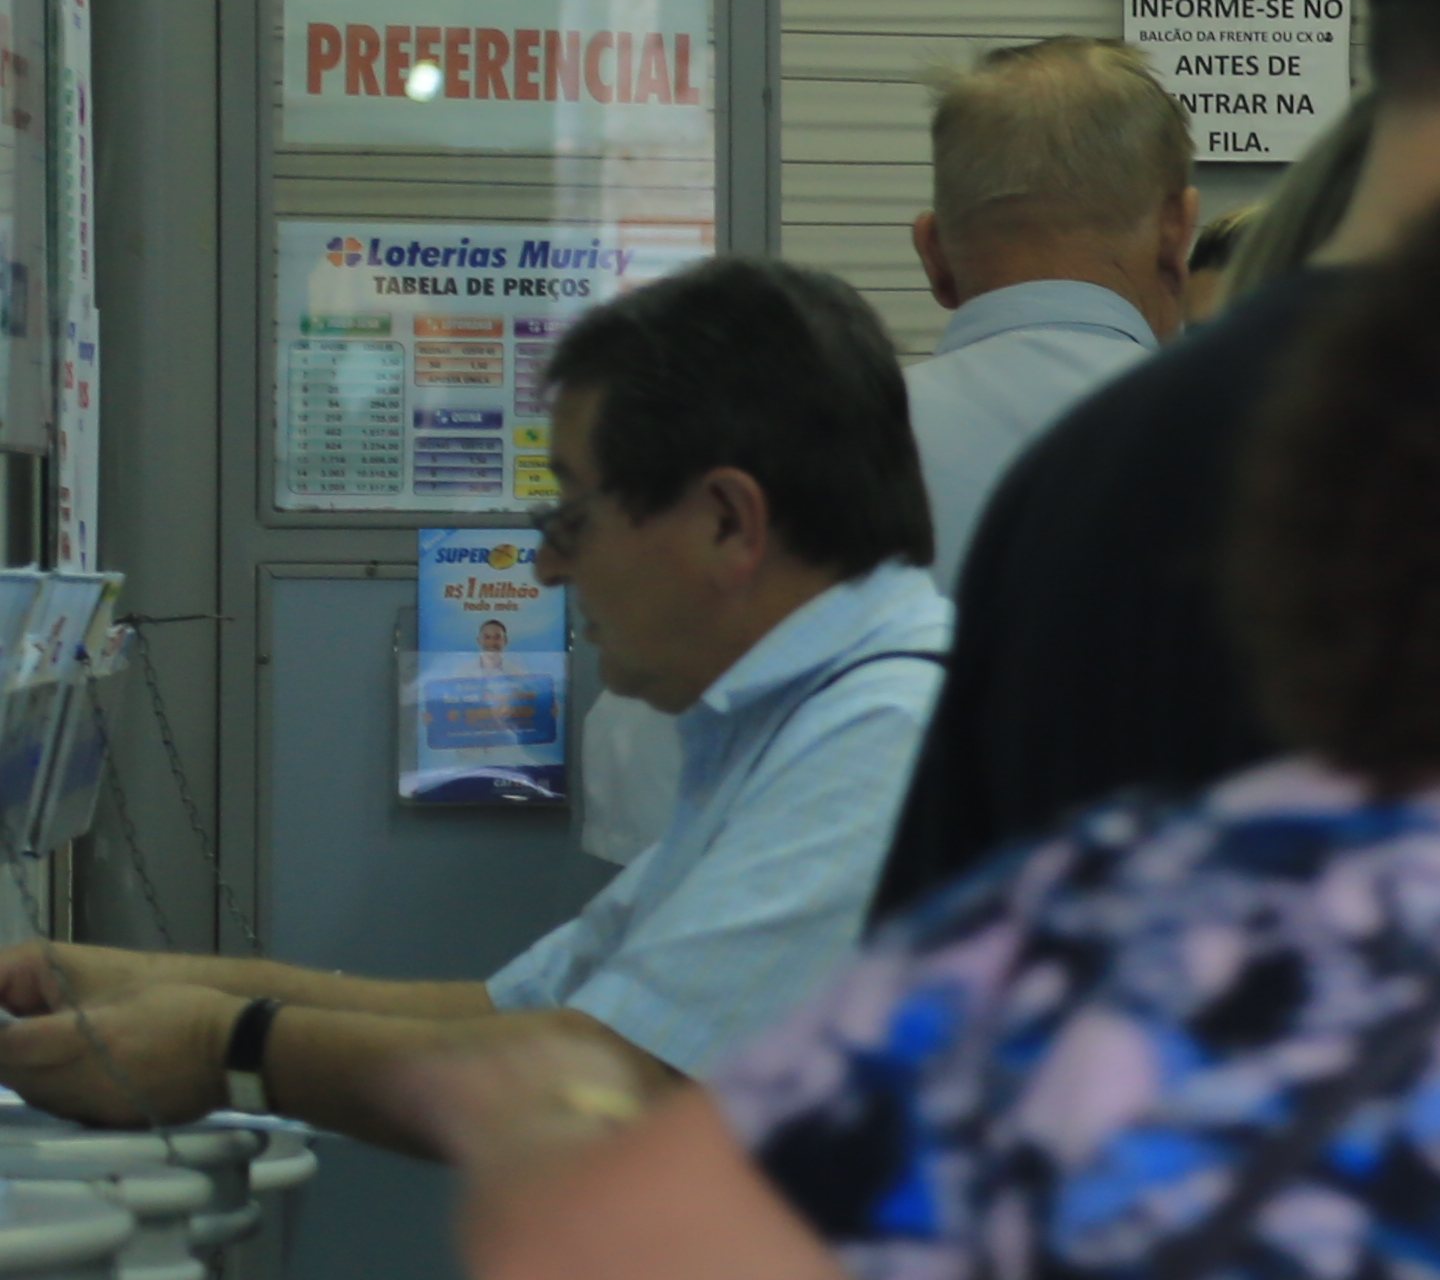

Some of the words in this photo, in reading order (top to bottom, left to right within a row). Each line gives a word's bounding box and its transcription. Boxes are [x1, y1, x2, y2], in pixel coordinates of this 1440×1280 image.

[1139, 28, 1193, 42] BALCÃO
[1197, 30, 1216, 42] DA
[1220, 30, 1268, 42] FRENTE
[1272, 31, 1292, 42] OU
[1296, 31, 1313, 42] CX
[306, 22, 699, 106] PREFERENCIAL
[1175, 55, 1260, 76] ANTES
[1269, 55, 1302, 77] DE
[1171, 93, 1268, 114] NTRAR
[1277, 93, 1315, 115] NA
[1209, 131, 1270, 153] FILA.
[367, 237, 507, 269] Loterias
[518, 237, 635, 275] Muricy
[374, 276, 458, 296] TABELA
[467, 277, 495, 296] DE
[503, 277, 591, 301] PREÇOS
[434, 547, 489, 565] SUPER
[479, 581, 540, 599] Milhão
[463, 599, 491, 612] todo
